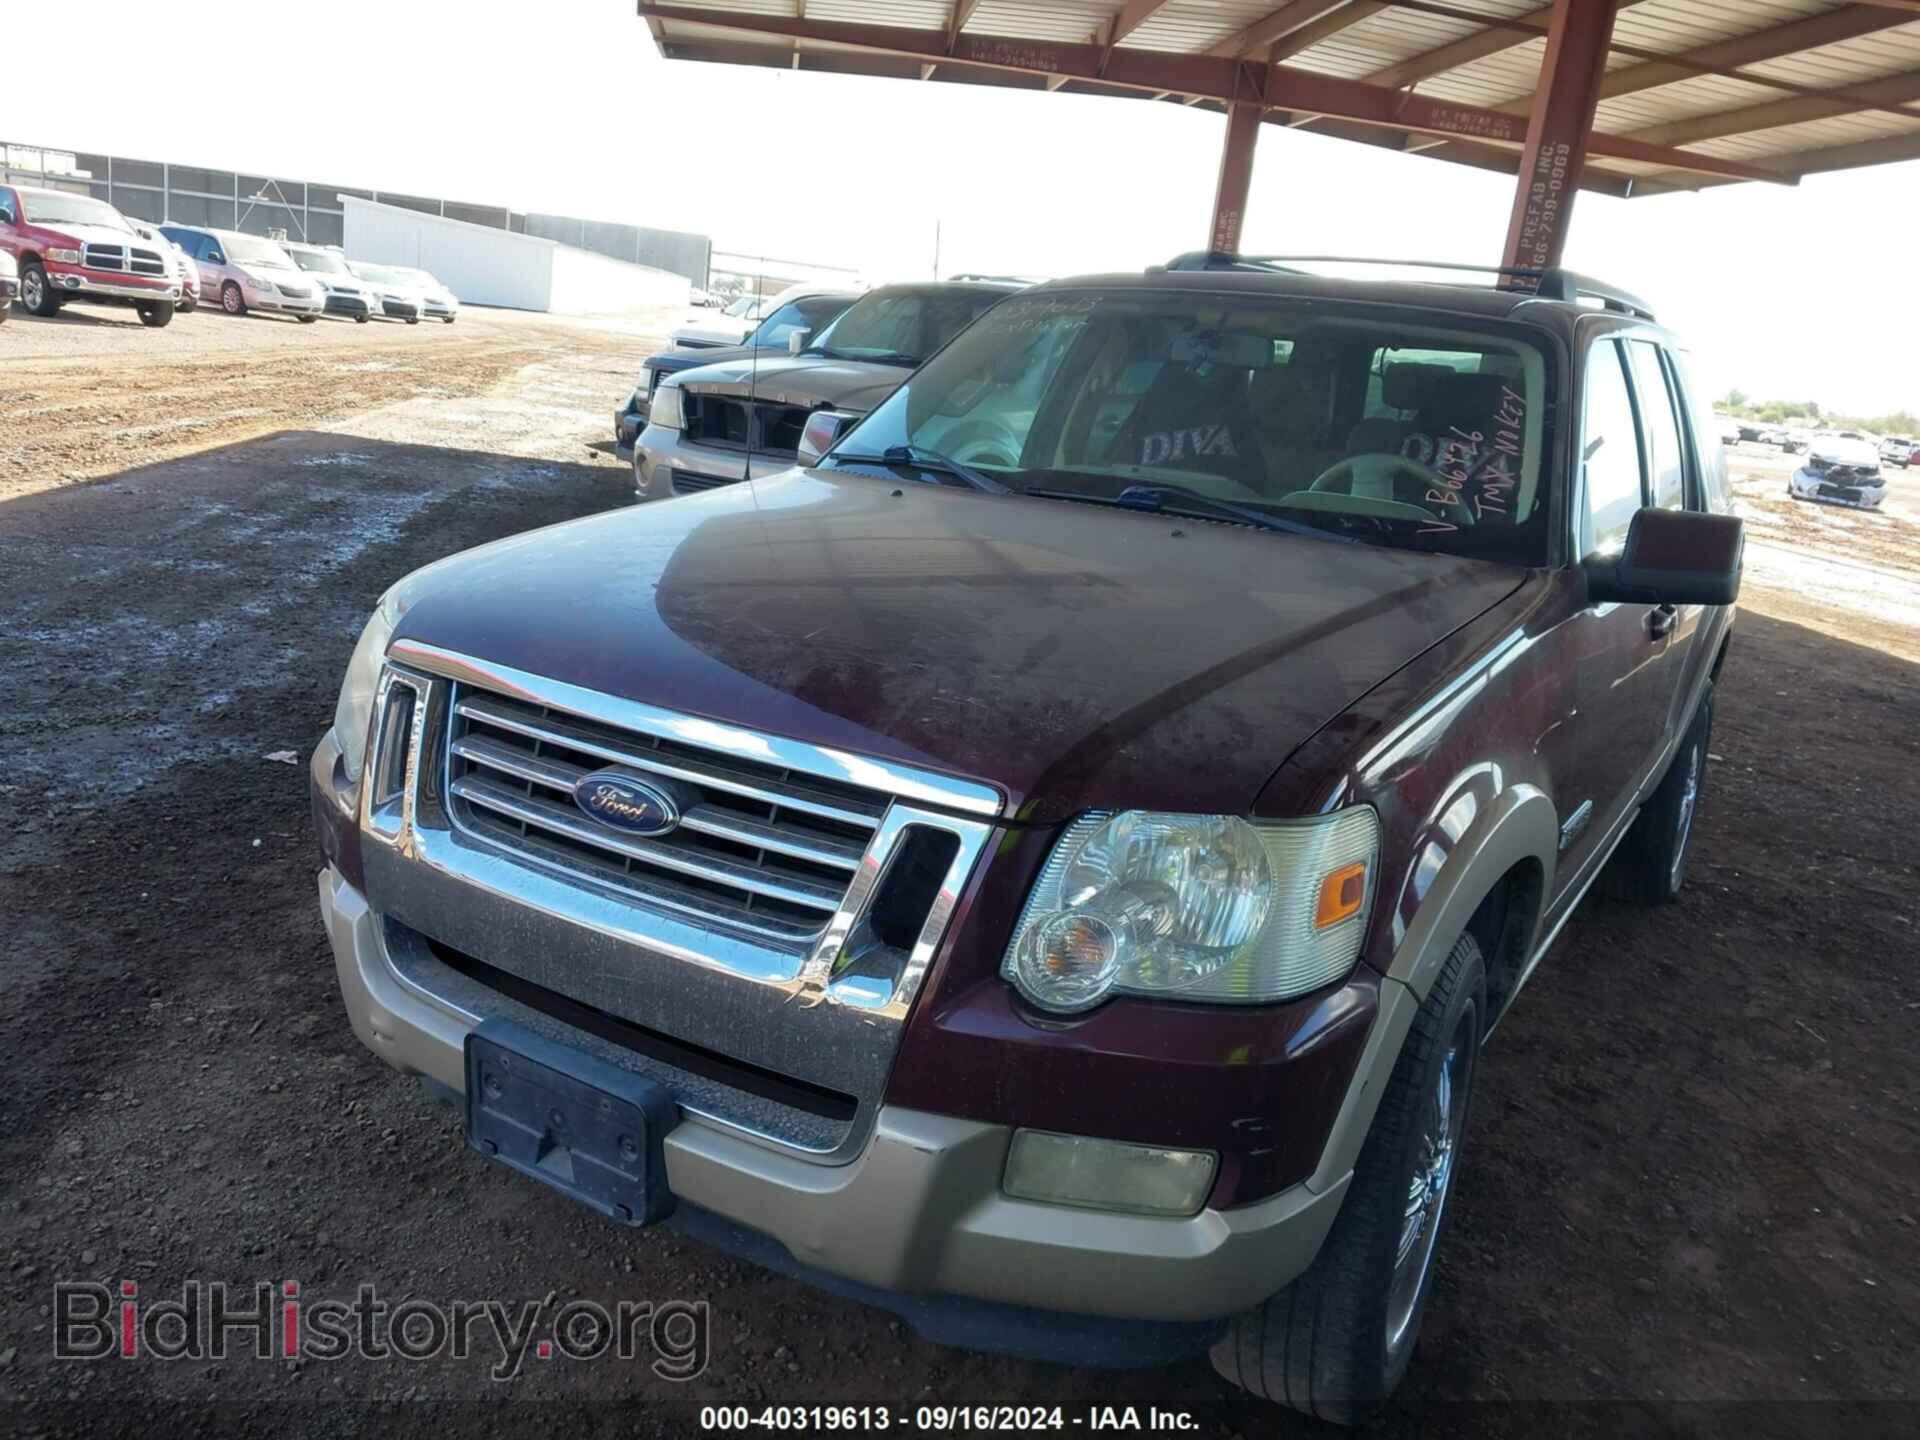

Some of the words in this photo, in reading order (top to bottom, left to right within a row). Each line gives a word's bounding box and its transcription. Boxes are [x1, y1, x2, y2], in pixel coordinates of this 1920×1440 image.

[1520, 182, 1547, 249] PREFAB
[1140, 424, 1239, 464] DIVA
[590, 783, 649, 821] Ford
